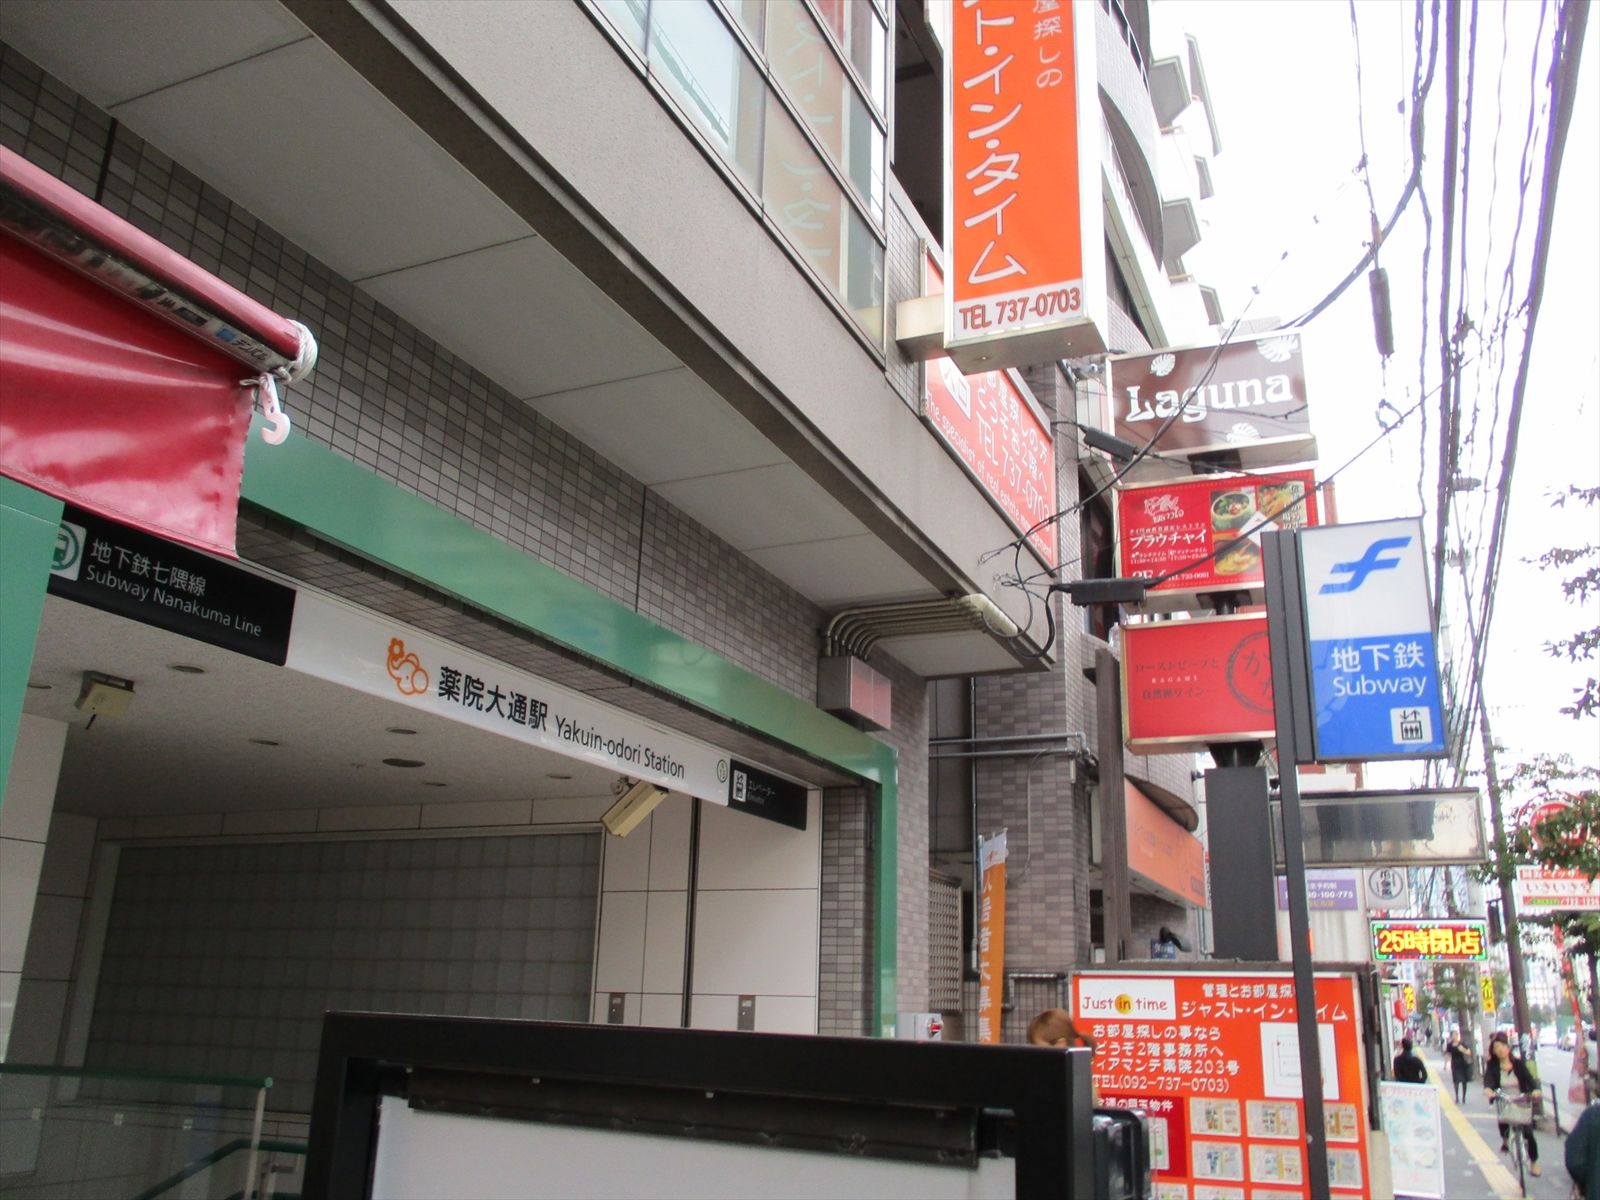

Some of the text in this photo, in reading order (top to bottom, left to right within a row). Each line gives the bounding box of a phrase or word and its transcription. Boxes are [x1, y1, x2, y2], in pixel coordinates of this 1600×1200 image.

[963, 0, 1028, 284] ト・イン・タイム
[959, 287, 1081, 330] TEL 737-0703
[1125, 374, 1293, 423] Laguna
[977, 412, 998, 466] TEL
[90, 538, 207, 597] 地下鉄七隈線
[86, 564, 262, 638] Subway Nanakuma Line
[1331, 641, 1425, 673] 地下鉄
[438, 665, 548, 732] 薬院大通駅
[1332, 675, 1427, 697] Subway
[555, 714, 685, 780] Yakuin-odori Station
[1379, 929, 1480, 955] 25時閉店
[1082, 996, 1168, 1011] Just in time
[1181, 1001, 1349, 1022] ジャスト・イン・イム
[1092, 1024, 1221, 1040] お部屋探しの事なら
[1091, 1058, 1240, 1075] ィアマンテ薬院203号
